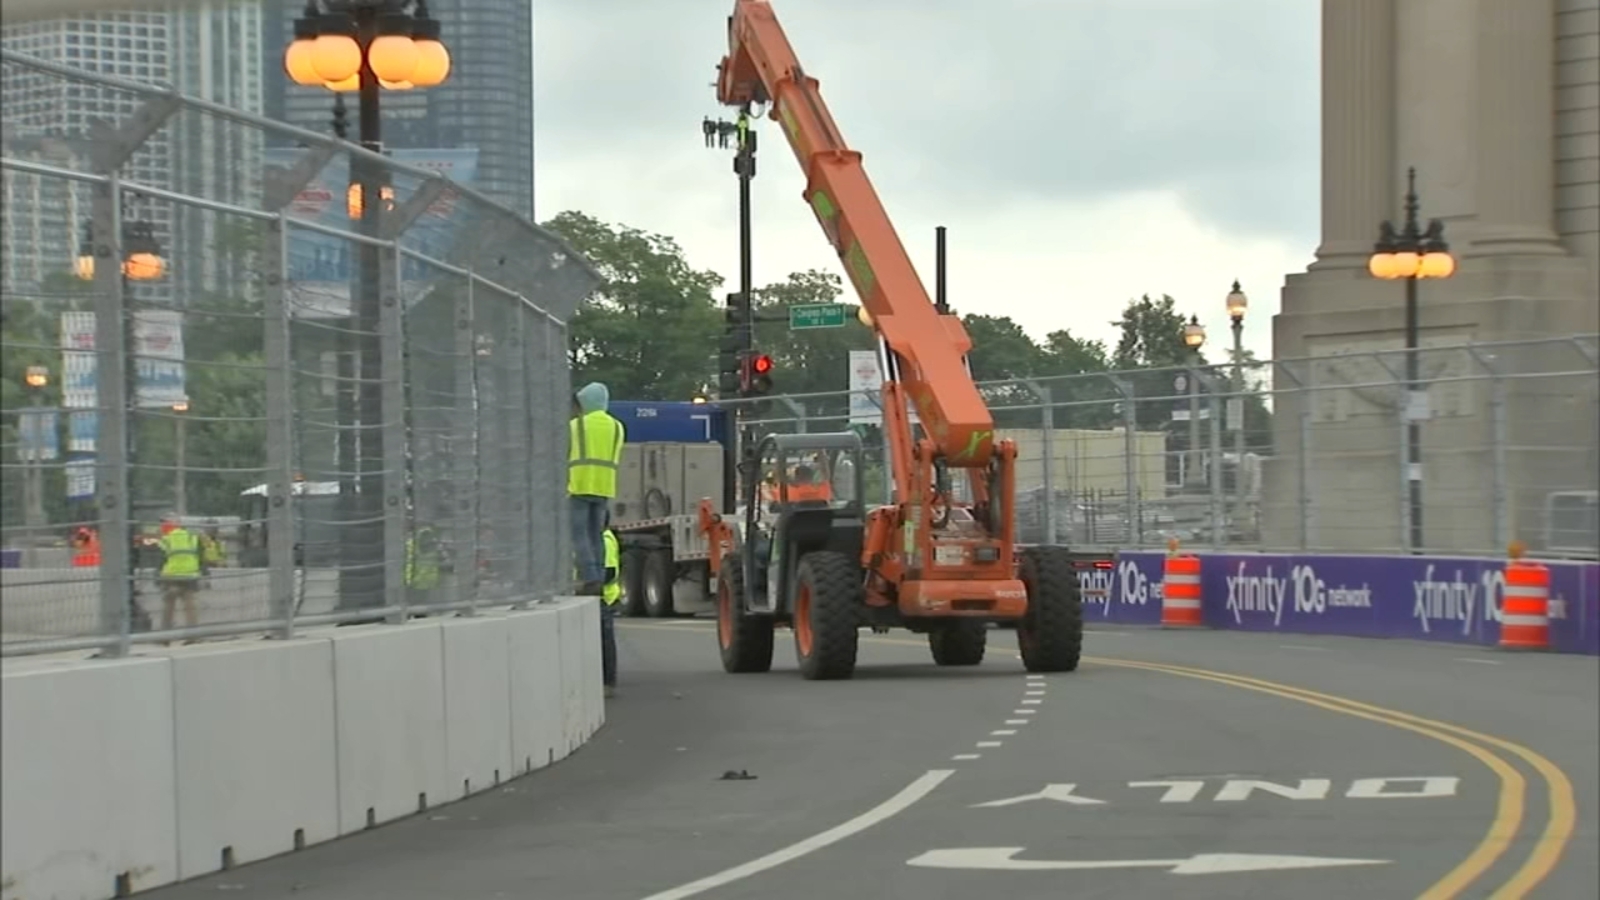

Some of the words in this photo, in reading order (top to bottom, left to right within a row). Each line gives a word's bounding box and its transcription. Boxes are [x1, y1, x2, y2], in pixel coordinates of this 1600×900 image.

[1076, 568, 1115, 617] nity
[1226, 561, 1287, 626] xfinity
[1291, 565, 1326, 613] 10G
[1328, 583, 1372, 608] network
[1413, 564, 1477, 636] xfinity
[1482, 569, 1505, 623] 10
[968, 776, 1460, 808] ONLY
